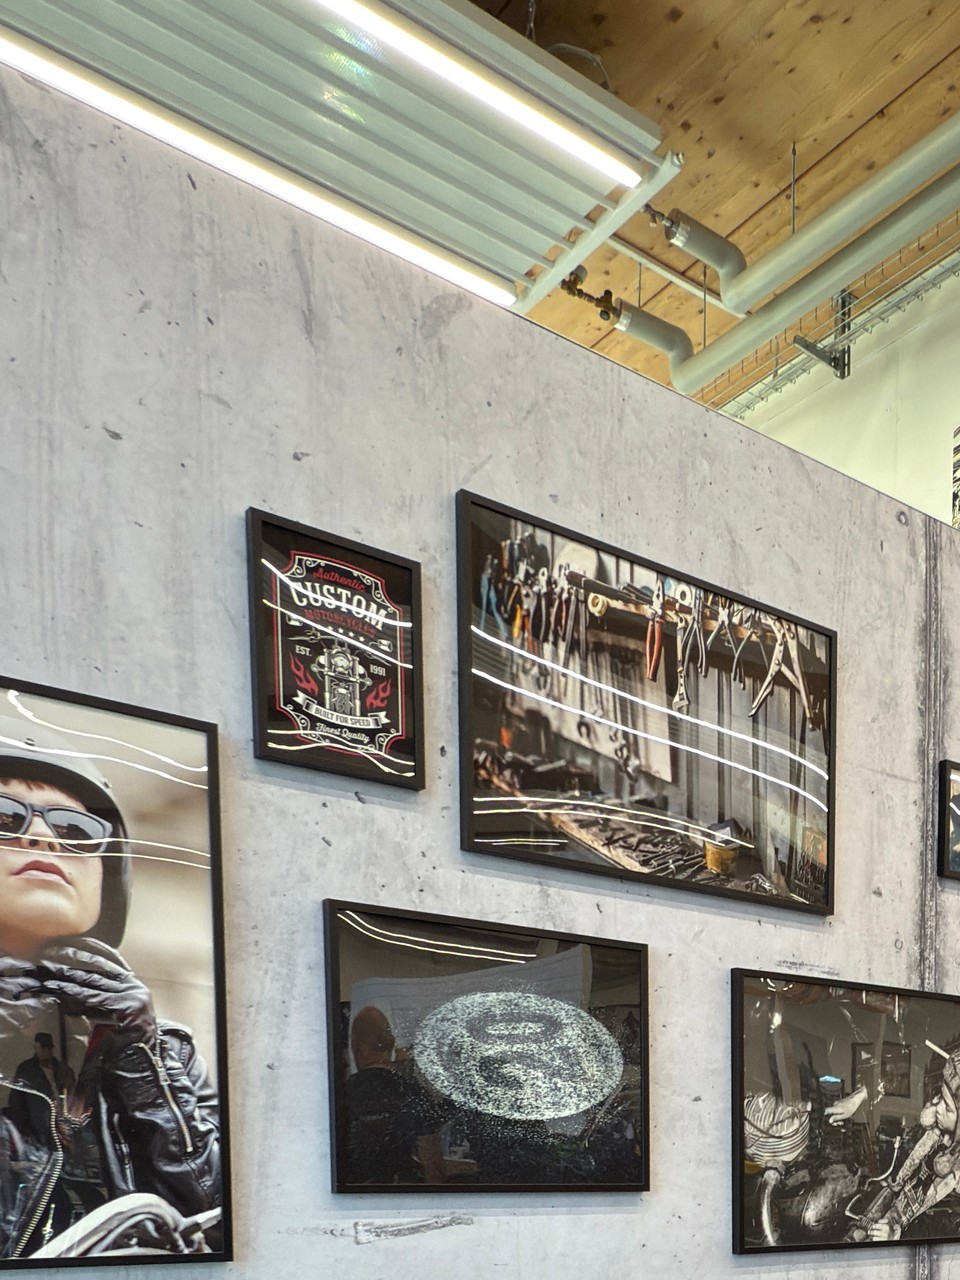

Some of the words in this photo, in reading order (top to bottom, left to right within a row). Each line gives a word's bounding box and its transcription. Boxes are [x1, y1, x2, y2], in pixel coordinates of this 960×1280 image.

[313, 568, 365, 592] Authentic
[290, 581, 388, 631] CUSTOM
[304, 609, 377, 638] MOTORCYCLES
[295, 645, 312, 656] EST.
[369, 664, 386, 677] 1991
[314, 705, 334, 720] BUILT
[335, 714, 349, 724] FOR
[350, 718, 371, 727] SPEED
[316, 722, 340, 736] Finest
[341, 728, 371, 743] Quality
